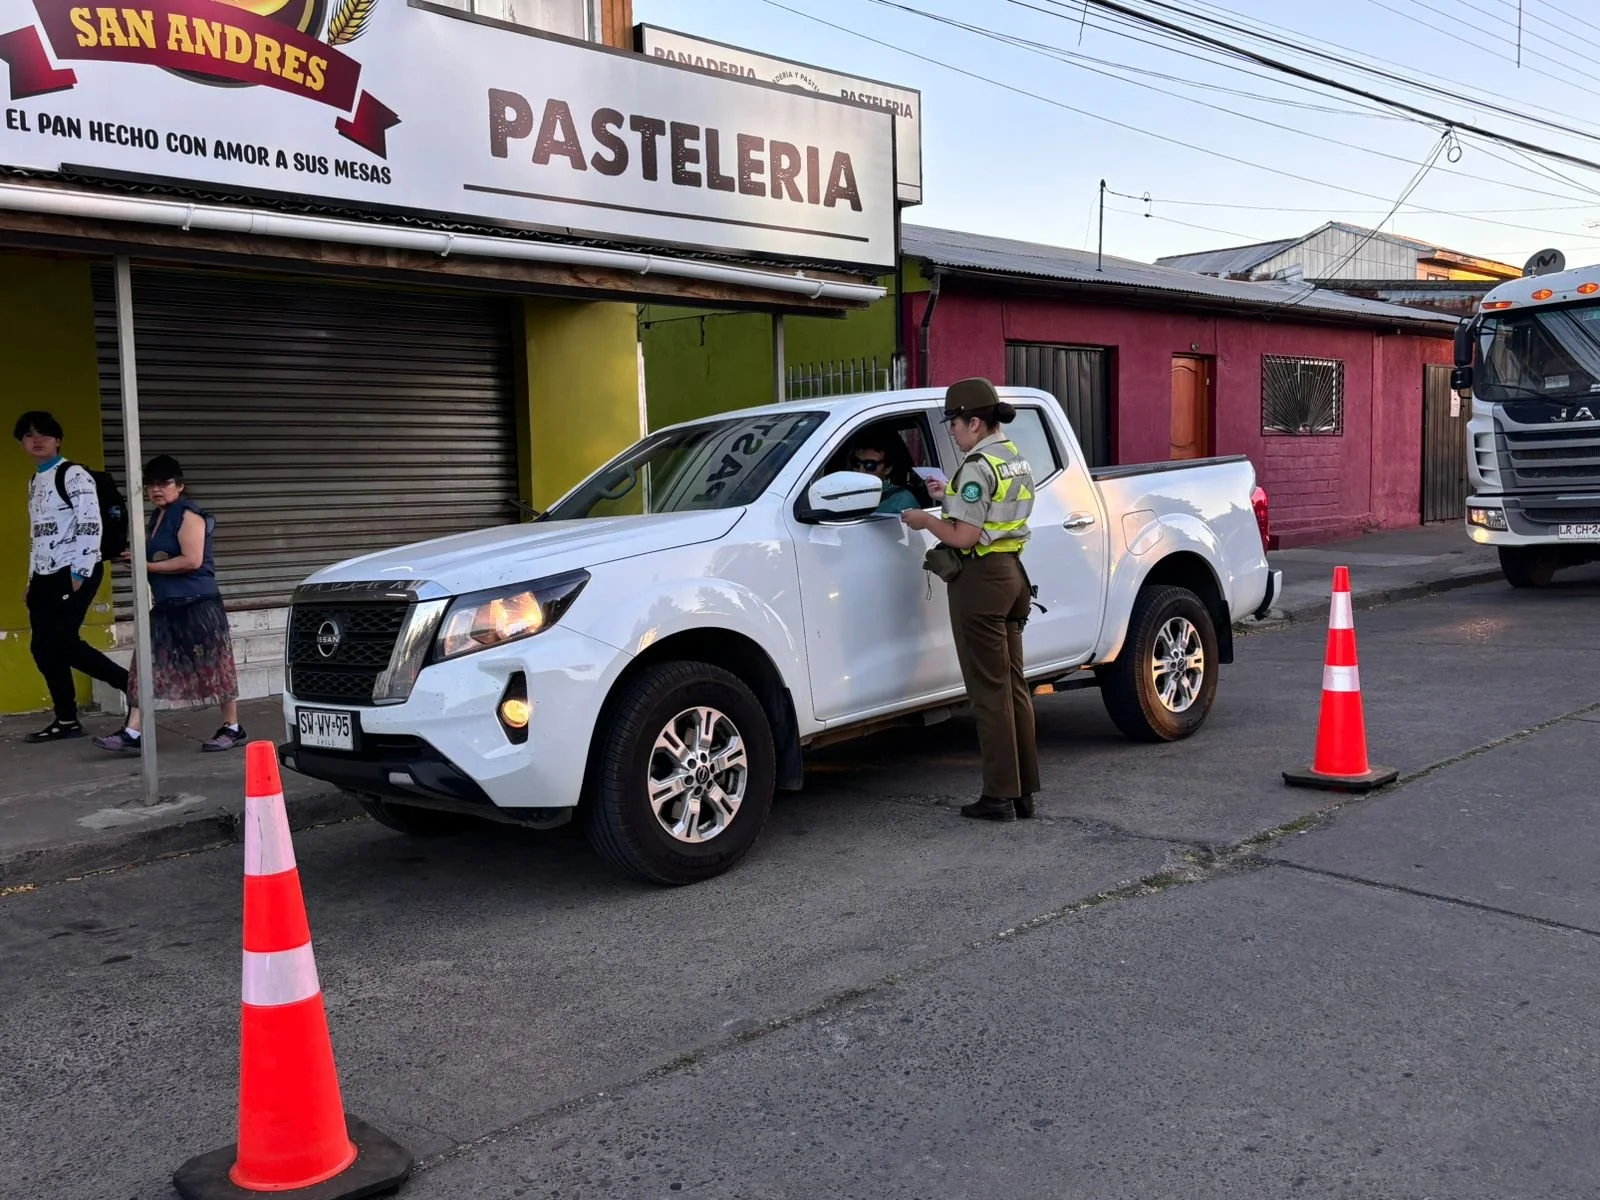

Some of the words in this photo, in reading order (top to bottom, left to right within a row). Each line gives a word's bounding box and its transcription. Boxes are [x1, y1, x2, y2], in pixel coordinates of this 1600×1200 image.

[70, 7, 157, 49] SAN
[167, 14, 328, 92] ANDRES
[6, 108, 31, 132] EL
[38, 112, 82, 140] PAN
[89, 120, 159, 150] HECHO
[166, 132, 207, 158] CON
[213, 139, 271, 168] AMOR
[275, 150, 288, 170] A
[293, 152, 329, 175] SUS
[334, 159, 392, 185] MESAS
[487, 87, 863, 213] PASTELERIA
